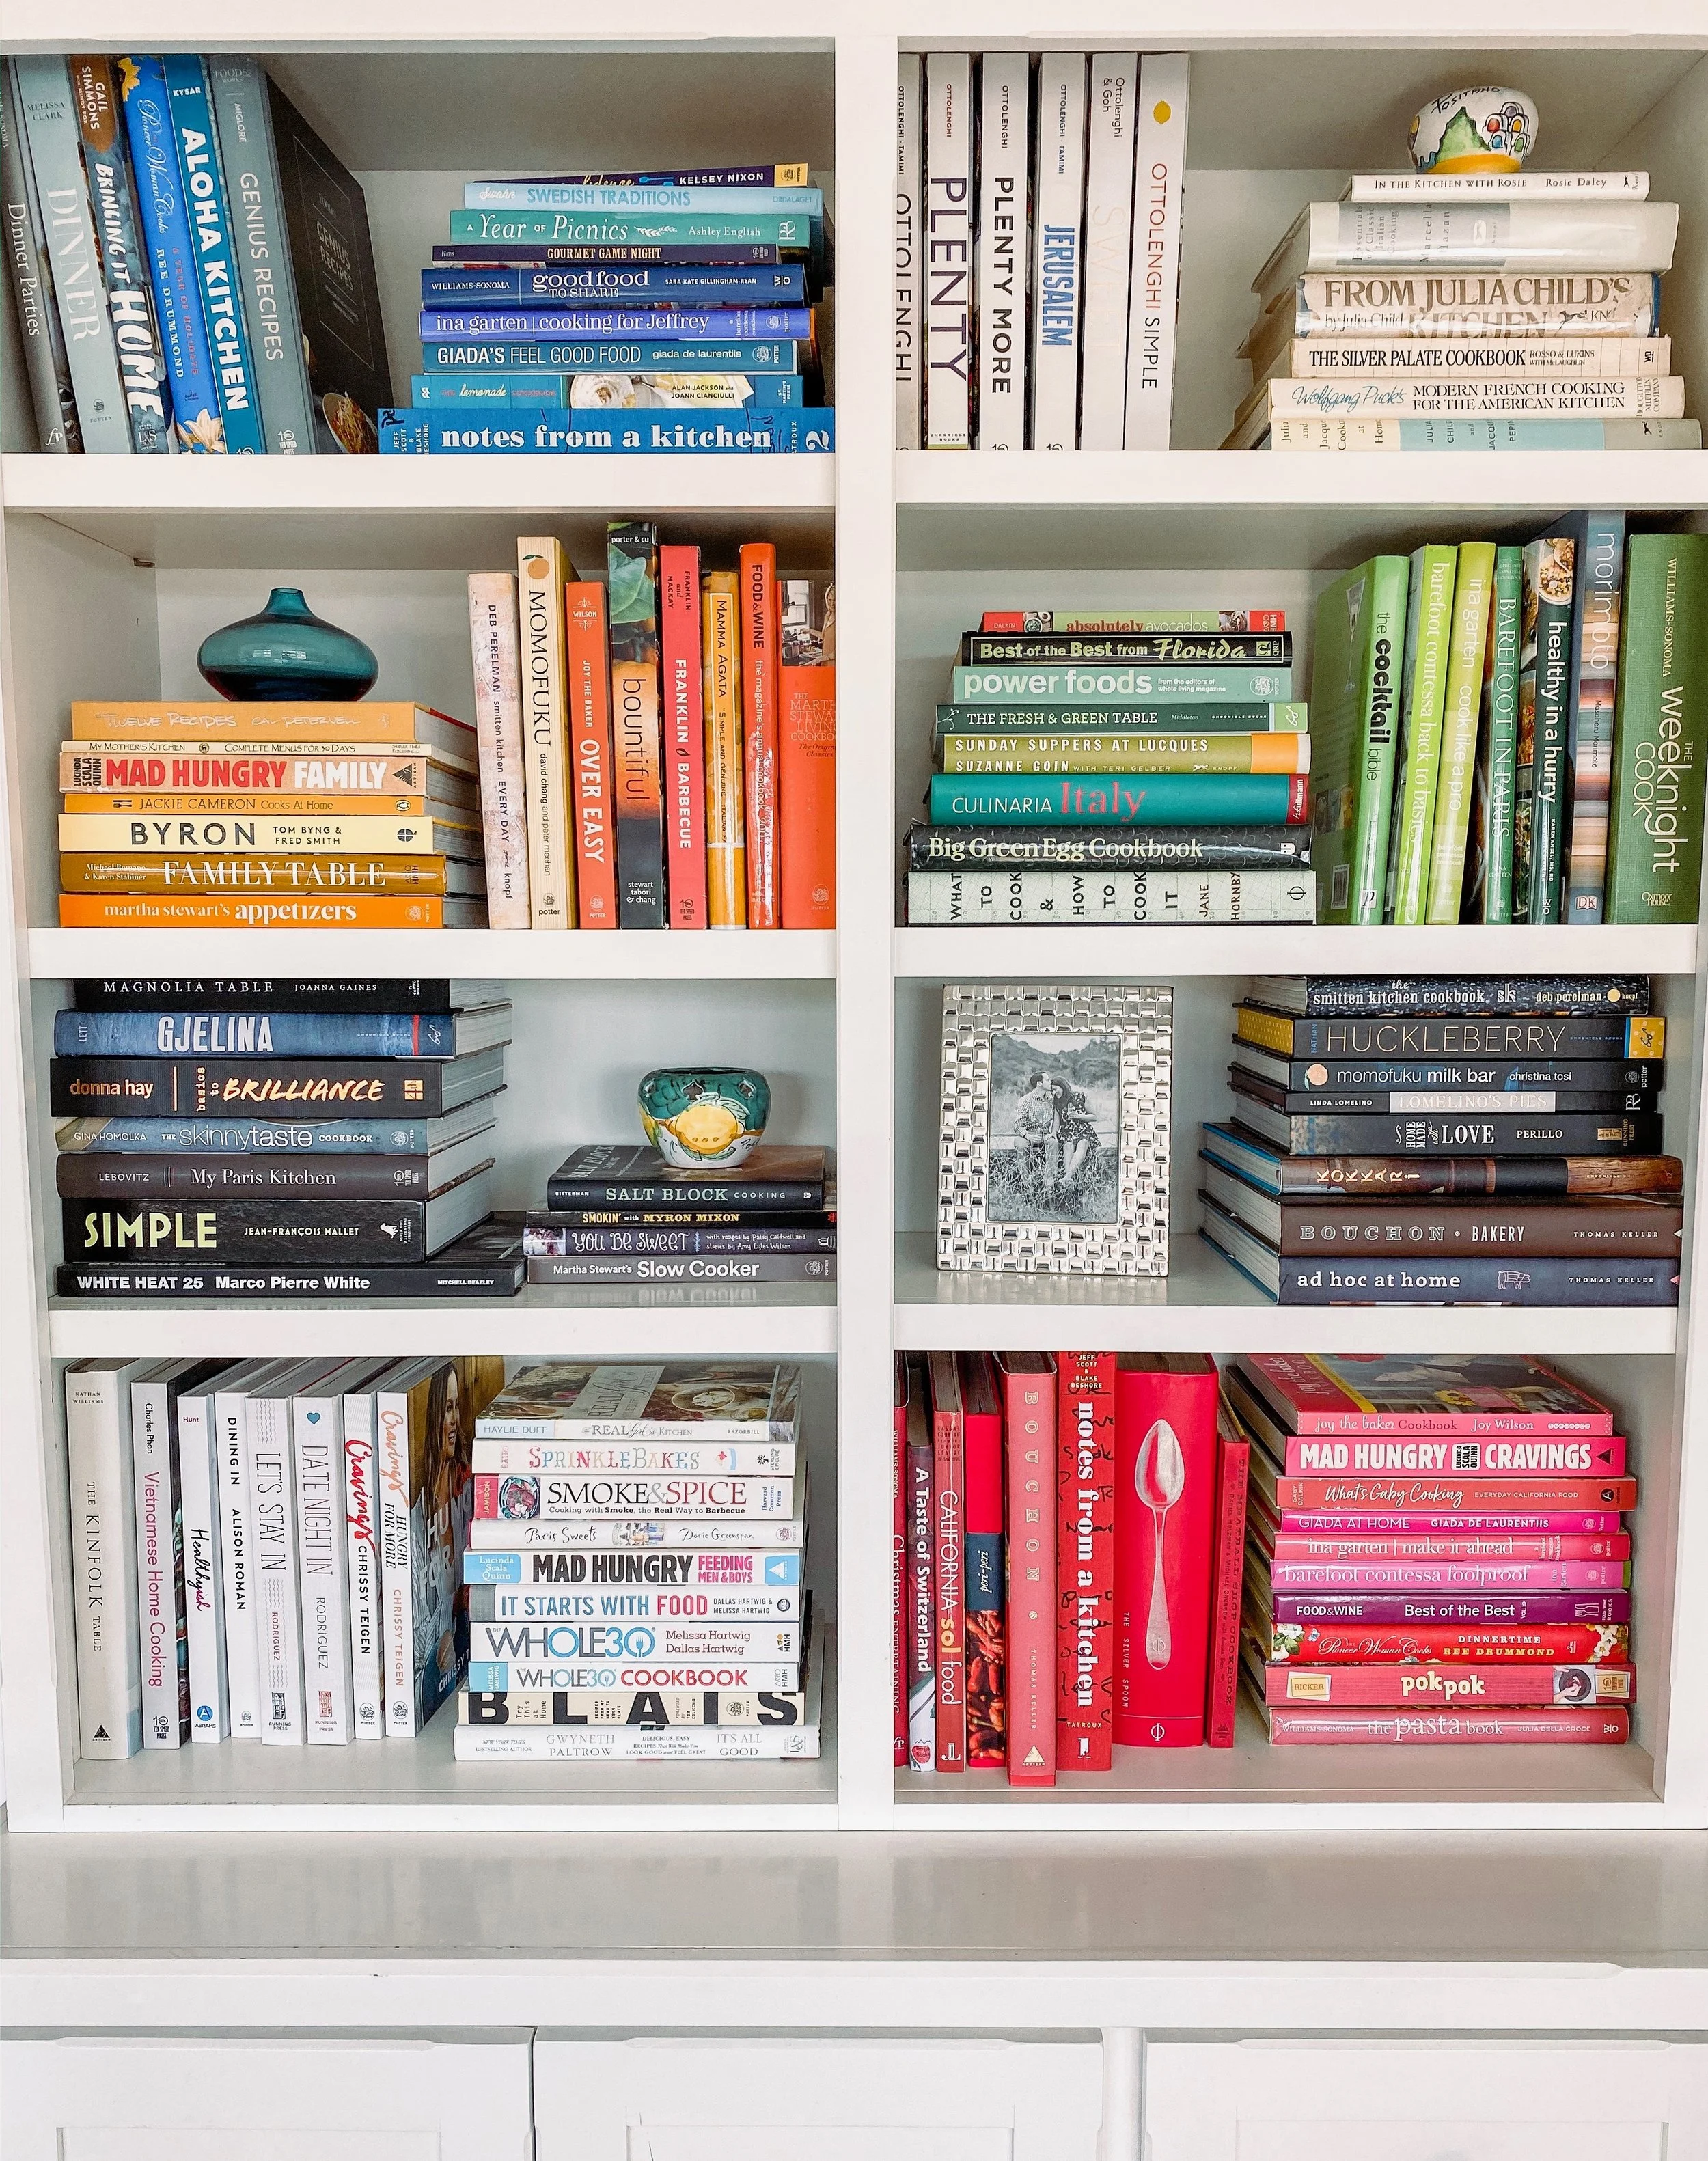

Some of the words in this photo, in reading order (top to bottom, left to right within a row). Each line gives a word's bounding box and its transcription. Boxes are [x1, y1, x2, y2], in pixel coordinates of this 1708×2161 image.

[82, 66, 100, 130] SIMMONS
[94, 81, 109, 113] GAIL
[173, 87, 201, 96] KYSAR
[680, 174, 723, 185] KELSEY
[727, 171, 764, 183] NIXON
[239, 172, 268, 259] GENIUS
[479, 214, 527, 239] Year
[552, 215, 628, 240] Picnics
[688, 225, 725, 238] Ashley
[729, 226, 761, 238] English
[993, 177, 1014, 296] PLENTY
[1146, 163, 1168, 309] OTTOLENGHI
[8, 202, 30, 271] Dinner
[19, 276, 40, 336] Parties
[46, 188, 100, 342] DINNER
[180, 128, 217, 252] ALOHA
[204, 264, 249, 411] KITCHEN
[931, 178, 967, 381] PLENTY
[1042, 225, 1075, 346] JERUSALEM
[253, 267, 284, 361] RECIPES
[992, 309, 1011, 394] MORE
[1142, 317, 1161, 389] SIMPLE
[1309, 350, 1338, 366] THE
[1342, 350, 1387, 366] SILVER
[1391, 350, 1442, 366] PALATE
[1446, 350, 1526, 366] COOKBOOK
[1413, 400, 1440, 410] FOR
[1443, 399, 1474, 410] THE
[1478, 398, 1553, 410] AMERICAN
[1558, 397, 1625, 409] KITCHEN
[1414, 385, 1478, 396] MODERN
[1485, 384, 1547, 396] FRENCH
[1552, 383, 1625, 395] COOKING
[441, 426, 524, 448] notes
[534, 424, 612, 448] from
[622, 429, 640, 448] a
[651, 424, 771, 449] kitchen
[1590, 532, 1617, 670] morimoto
[1376, 612, 1390, 634] the
[529, 590, 552, 747] MOMOFUKU
[1541, 621, 1568, 702] healthy
[675, 659, 688, 743] FRANKLIN
[964, 674, 1059, 698] power
[1064, 670, 1153, 694] foods
[1370, 639, 1394, 743] cocktail
[967, 713, 995, 724] THE
[1000, 713, 1045, 724] FRESH
[1062, 713, 1107, 724] GREEN
[1112, 712, 1157, 723] TABLE
[1545, 706, 1564, 725] in
[622, 678, 650, 801] bountiful
[955, 739, 1017, 752] SUNDAY
[1028, 739, 1102, 752] SUPPERS
[1112, 739, 1129, 752] AT
[1138, 739, 1208, 752] LUCQUES
[1544, 728, 1558, 741] a
[106, 758, 165, 787] MAD
[173, 760, 287, 788] HUNGRY
[294, 761, 388, 788] FAMILY
[579, 739, 601, 798] OVER
[1366, 748, 1382, 781] bible
[1537, 745, 1563, 803] hurry
[677, 762, 691, 849] BARBECUE
[131, 823, 255, 846] BYRON
[273, 826, 297, 834] TOM
[301, 826, 331, 834] BYNG
[582, 807, 604, 863] EASY
[1577, 896, 1596, 910] DK
[156, 1017, 273, 1054] GJELINA
[1327, 1025, 1567, 1052] HUCKLEBERRY
[1337, 1068, 1421, 1084] momofuku
[1427, 1068, 1462, 1083] milk
[1467, 1068, 1496, 1083] bar
[1509, 1071, 1551, 1082] christina
[1554, 1071, 1571, 1081] tosi
[605, 1189, 654, 1201] SALT
[661, 1188, 728, 1201] BLOCK
[85, 1213, 217, 1248] SIMPLE
[325, 1227, 359, 1236] MALLET
[77, 1276, 130, 1289] WHITE
[135, 1277, 178, 1289] HEAT
[182, 1276, 204, 1289] 25
[215, 1276, 266, 1289] Marco
[270, 1276, 319, 1290] Pierre
[324, 1276, 370, 1289] White
[553, 1265, 587, 1274] Martha
[590, 1265, 632, 1274] Stewart's
[637, 1261, 685, 1277] Slow
[689, 1260, 759, 1277] Cooker
[1297, 1272, 1322, 1287] ad
[1330, 1271, 1367, 1287] hoc
[1374, 1274, 1394, 1287] at
[1401, 1272, 1460, 1288] home
[228, 1417, 238, 1465] DINING
[1077, 1401, 1094, 1481] notes
[1300, 1444, 1349, 1470] MAD
[1354, 1443, 1448, 1470] HUNGRY
[1485, 1444, 1592, 1470] CRAVINGS
[230, 1472, 240, 1485] IN
[302, 1444, 329, 1494] DATE
[915, 1467, 931, 1482] A
[303, 1498, 331, 1557] NIGHT
[915, 1487, 930, 1535] Taste
[1077, 1489, 1094, 1562] from
[232, 1509, 243, 1558] ALISON
[918, 1540, 930, 1555] of
[85, 1515, 103, 1608] KINFOLK
[306, 1561, 333, 1576] IN
[532, 1555, 587, 1583] MAD
[592, 1555, 693, 1583] HUNGRY
[978, 1550, 991, 1593] peri-peri
[234, 1563, 246, 1610] ROMAN
[1077, 1571, 1093, 1587] a
[501, 1597, 516, 1616] IT
[525, 1596, 593, 1616] STARTS
[602, 1596, 648, 1615] WITH
[657, 1595, 708, 1615] FOOD
[917, 1558, 931, 1673] Switzerland
[1404, 1603, 1435, 1617] Best
[1440, 1603, 1454, 1616] of
[1457, 1603, 1480, 1617] the
[1484, 1603, 1515, 1617] Best
[92, 1617, 102, 1651] TABLE
[1458, 1636, 1541, 1644] DINNERTIME
[1077, 1596, 1099, 1708] kitchen
[1444, 1647, 1470, 1656] REE
[1476, 1647, 1554, 1656] DRUMMOND
